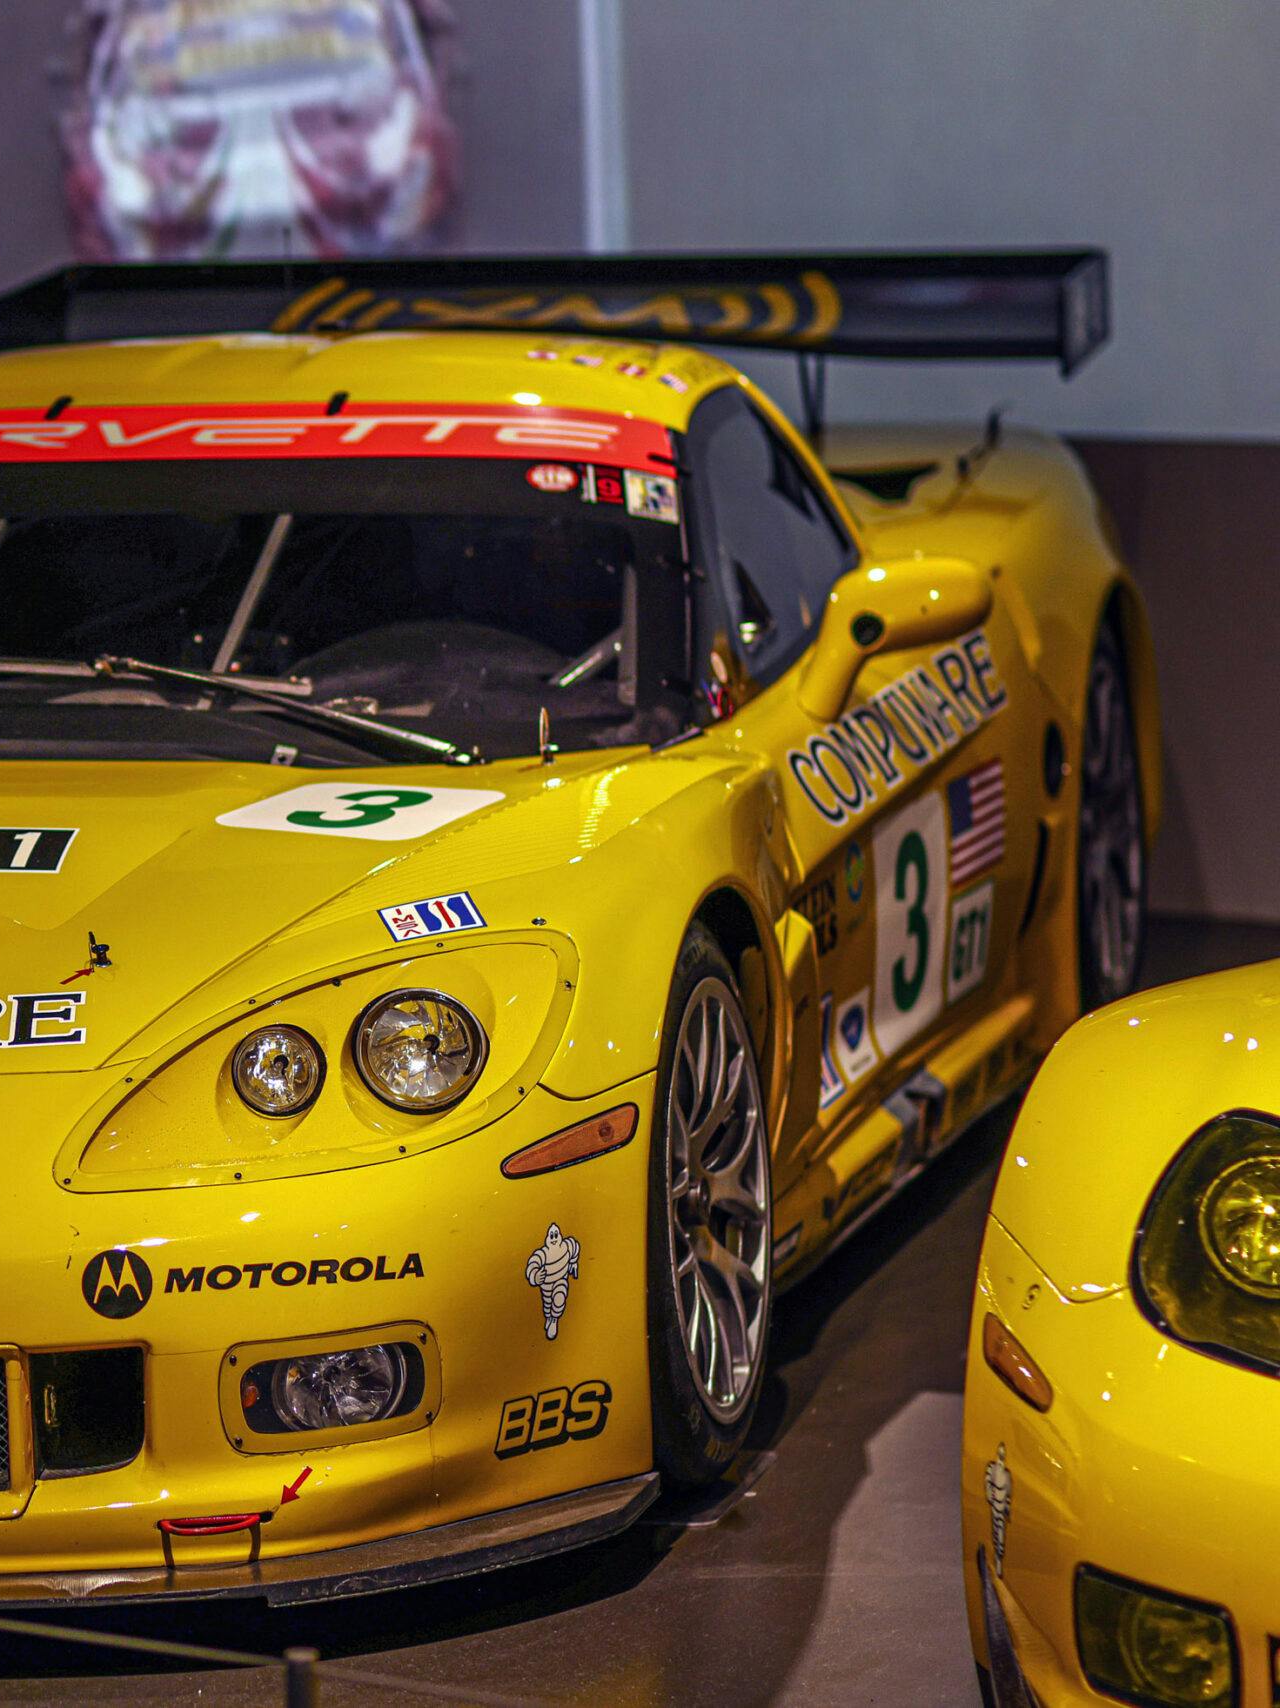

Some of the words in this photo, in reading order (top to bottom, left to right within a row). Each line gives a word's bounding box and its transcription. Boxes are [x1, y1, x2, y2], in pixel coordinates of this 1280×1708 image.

[786, 628, 1007, 828] COMPUWARE
[285, 789, 434, 829] 3
[891, 829, 929, 1012] 3
[163, 1252, 425, 1294] MOTOROLA
[493, 1379, 613, 1461] BBS
